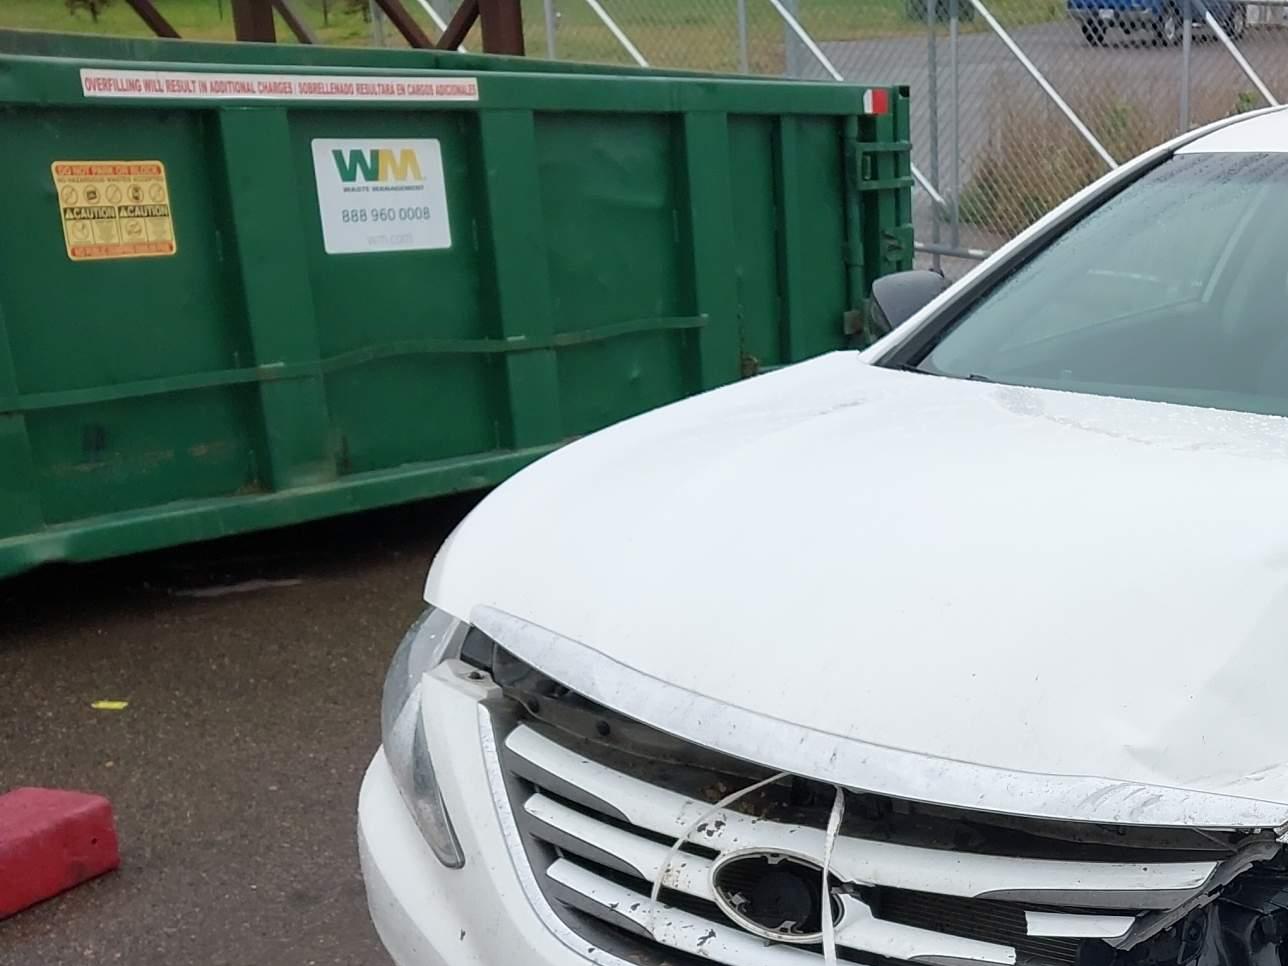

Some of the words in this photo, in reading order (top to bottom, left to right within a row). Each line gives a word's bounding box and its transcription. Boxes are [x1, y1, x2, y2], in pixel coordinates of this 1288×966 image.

[84, 77, 141, 92] OVERFILLING
[143, 79, 164, 93] WILL
[165, 79, 196, 93] RESULT
[199, 80, 207, 93] IN
[209, 80, 256, 94] ADDITIONAL
[257, 81, 293, 95] CHARGES
[397, 83, 405, 96] EN
[407, 83, 433, 96] CARGOS
[331, 148, 423, 182] WM
[372, 184, 424, 192] MANAGEMENT
[73, 207, 115, 218] CAUTION
[127, 205, 168, 217] CAUTION
[341, 208, 368, 223] 888
[371, 207, 396, 222] 960
[399, 206, 431, 221] 0008
